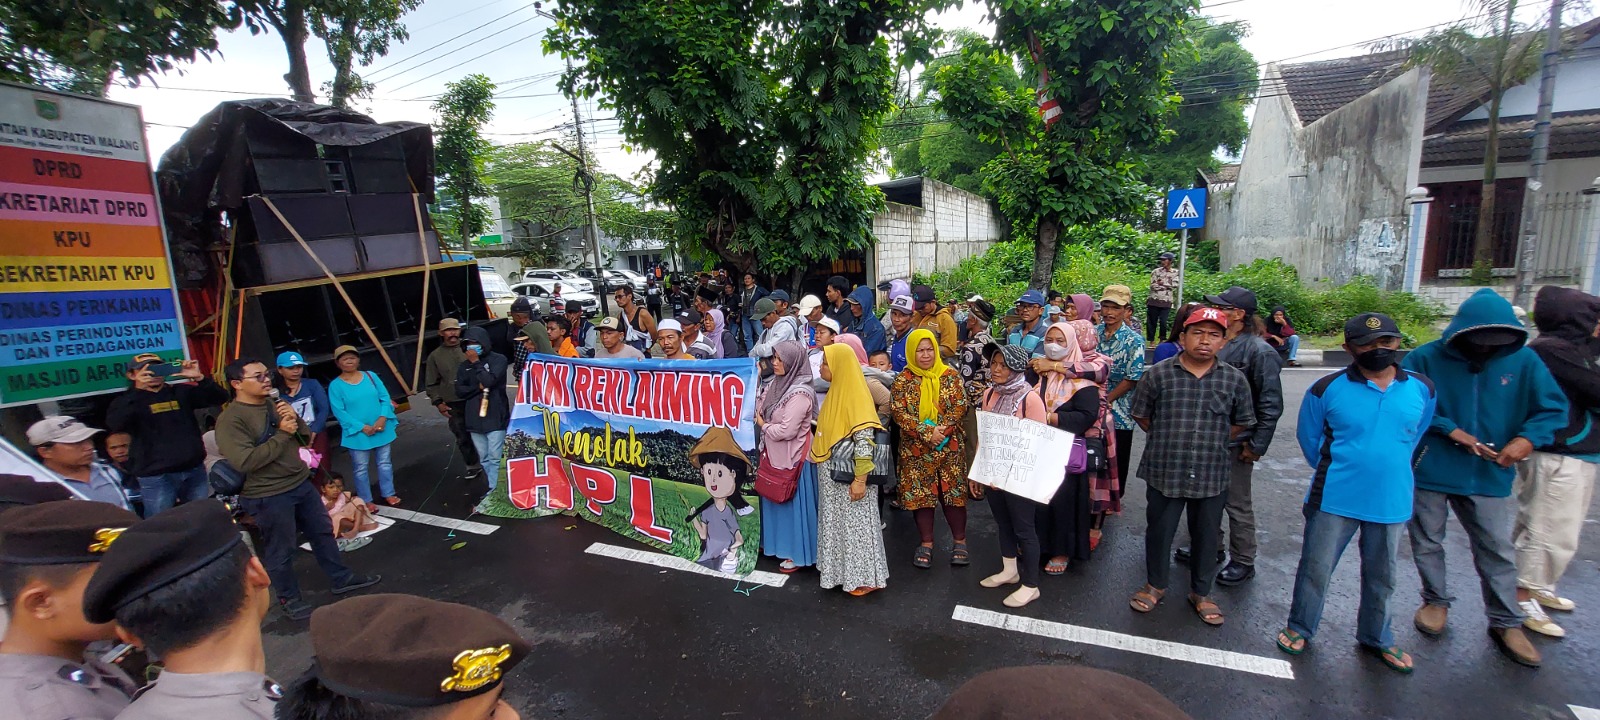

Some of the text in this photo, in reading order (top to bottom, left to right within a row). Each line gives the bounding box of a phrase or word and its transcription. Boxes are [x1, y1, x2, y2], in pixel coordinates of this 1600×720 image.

[0, 122, 28, 137] TAH
[31, 126, 96, 146] KABUPATEN
[98, 136, 140, 151] MALANG
[33, 158, 82, 179] DPRD
[105, 200, 148, 218] DPRD
[54, 231, 91, 248] KPU
[124, 265, 155, 281] KPU
[1, 297, 162, 320] DINAS PERIKANAN
[0, 322, 174, 347] DINAS PERINDUSTRIAN
[15, 337, 165, 361] DAN PERDAGANGAN
[7, 370, 81, 393] MASJID
[573, 364, 745, 431] REKLAIMING
[532, 405, 647, 468] Menolak
[506, 455, 673, 544] HPL
